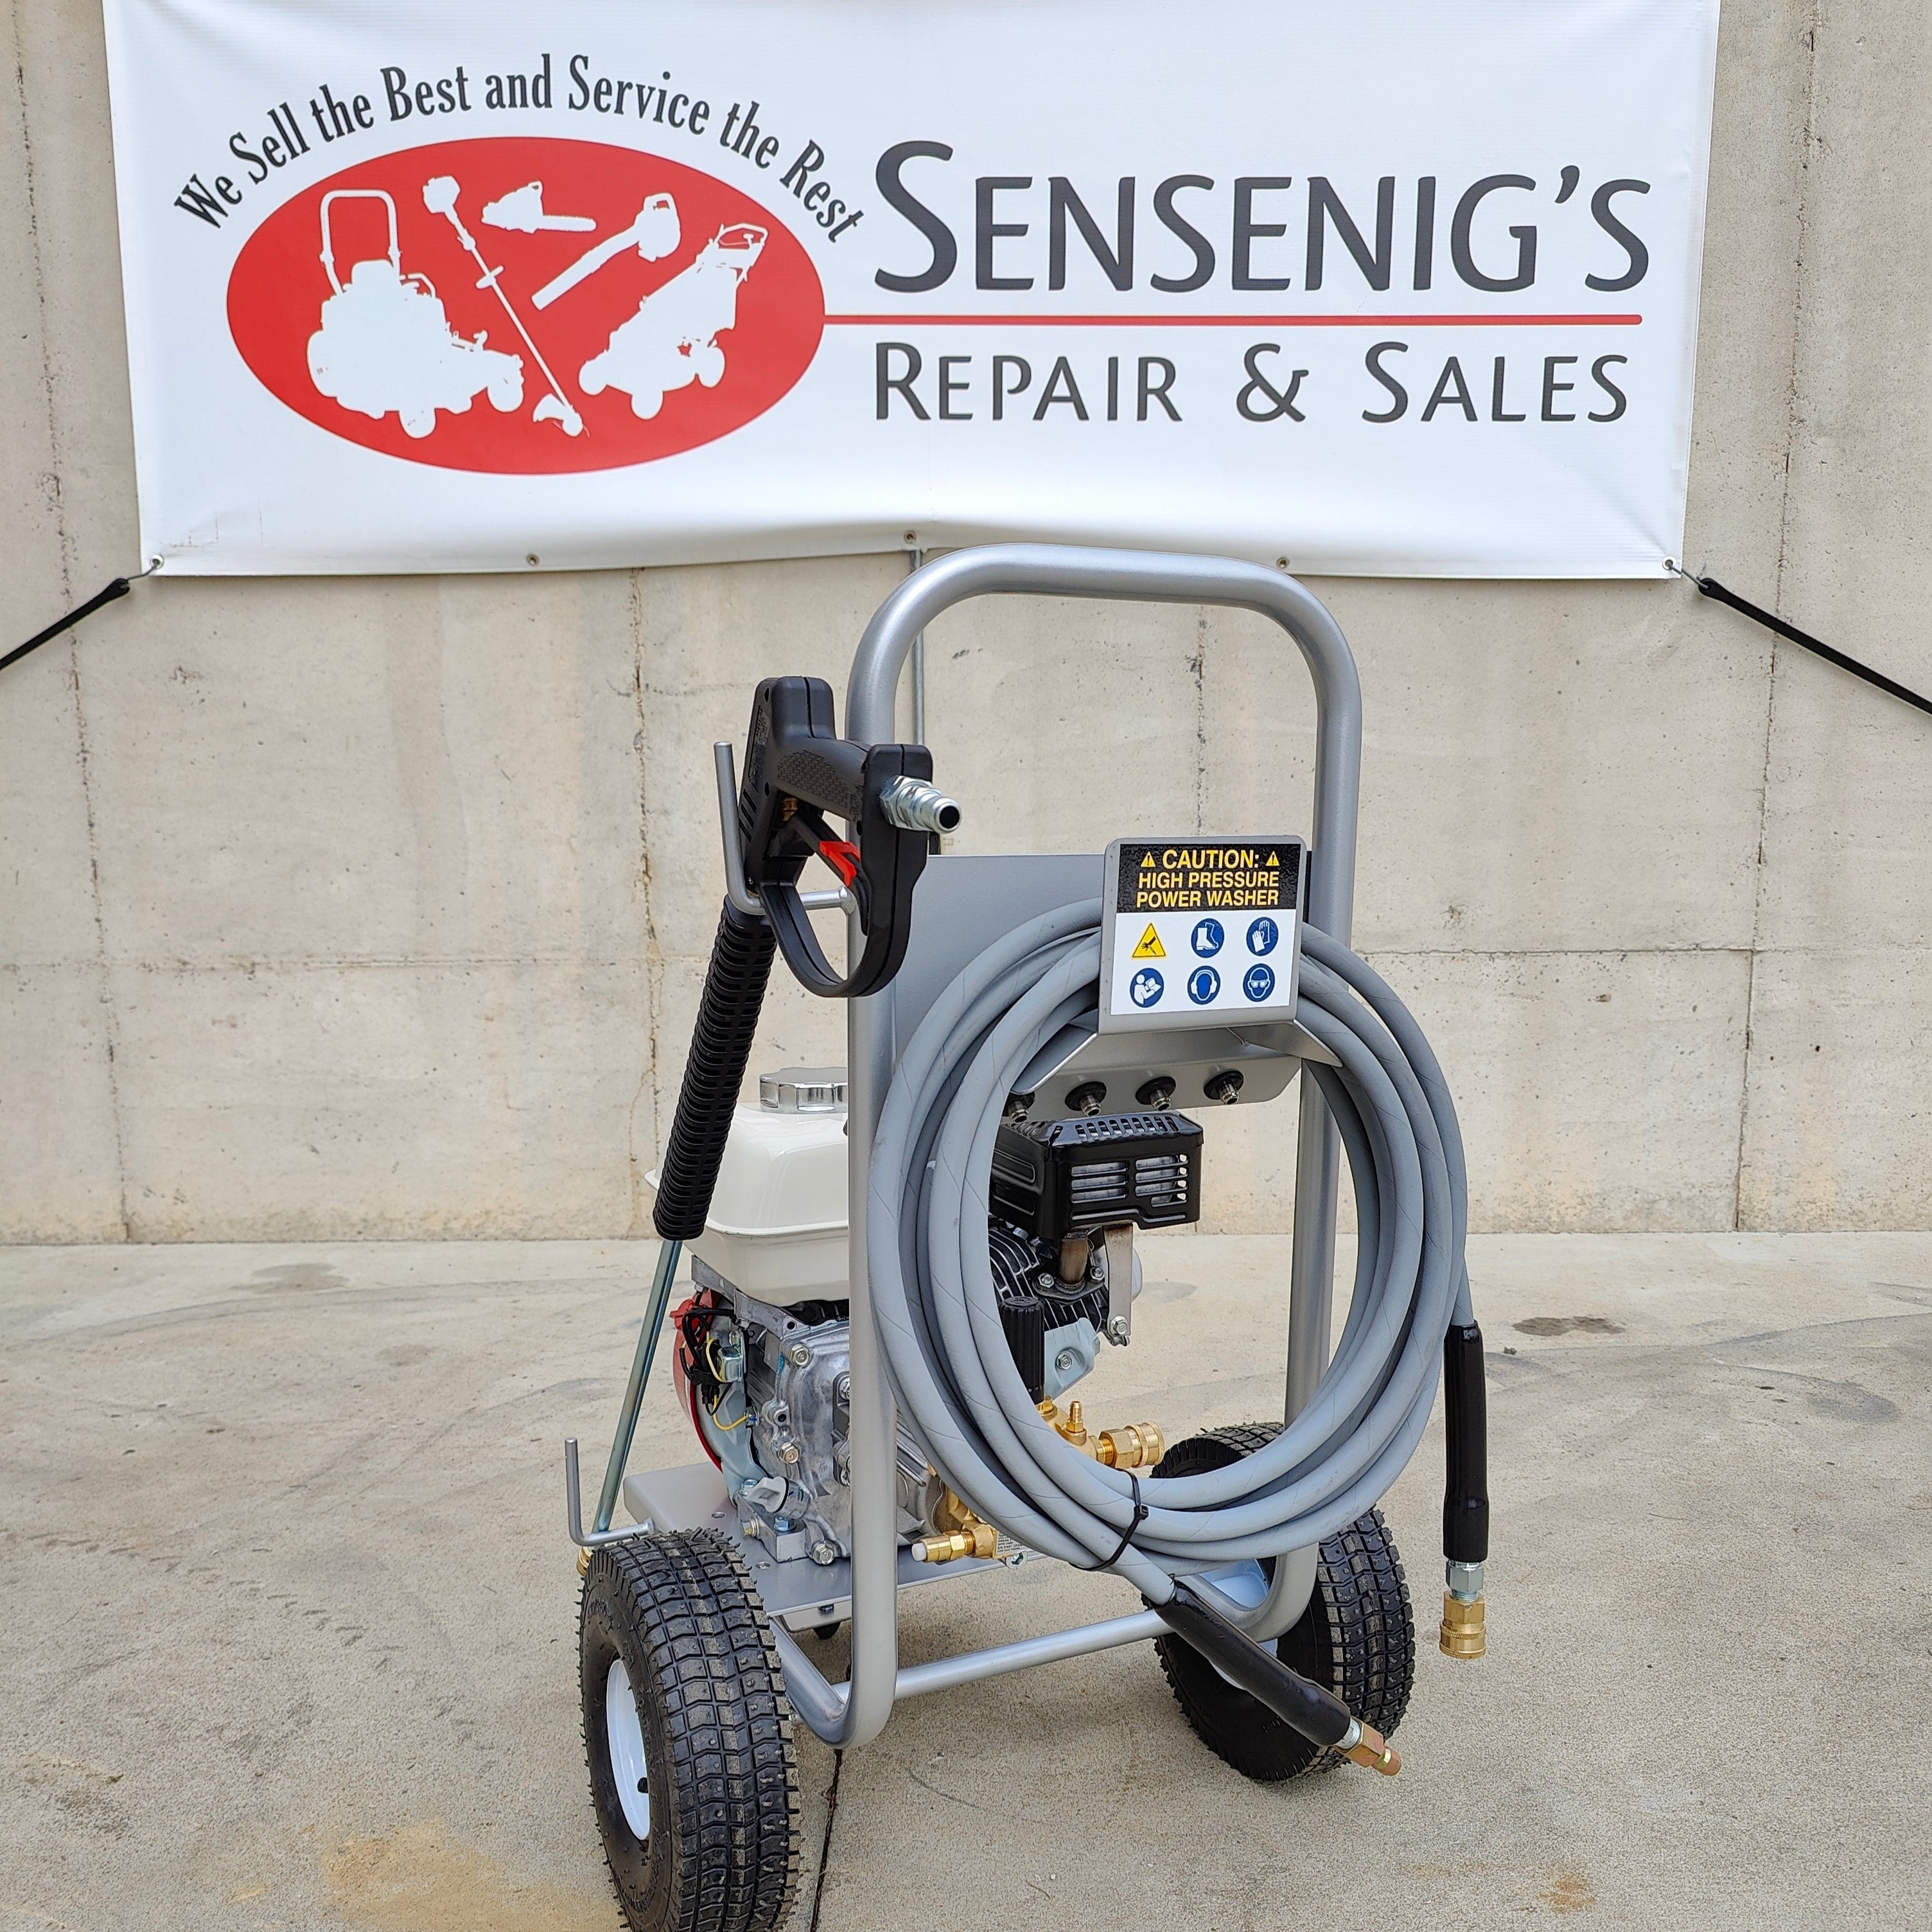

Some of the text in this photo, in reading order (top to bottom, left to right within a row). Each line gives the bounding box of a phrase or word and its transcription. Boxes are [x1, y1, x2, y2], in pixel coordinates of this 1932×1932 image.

[174, 53, 864, 243] We Sell the Best and Service the Rest
[874, 140, 1651, 293] SENSENIG'S
[876, 341, 1628, 423] REPAIR & SALES
[1138, 871, 1279, 889] HIGH PRESSURE
[1163, 849, 1259, 869] CAUTION:
[1136, 890, 1279, 908] POWER WASHER
